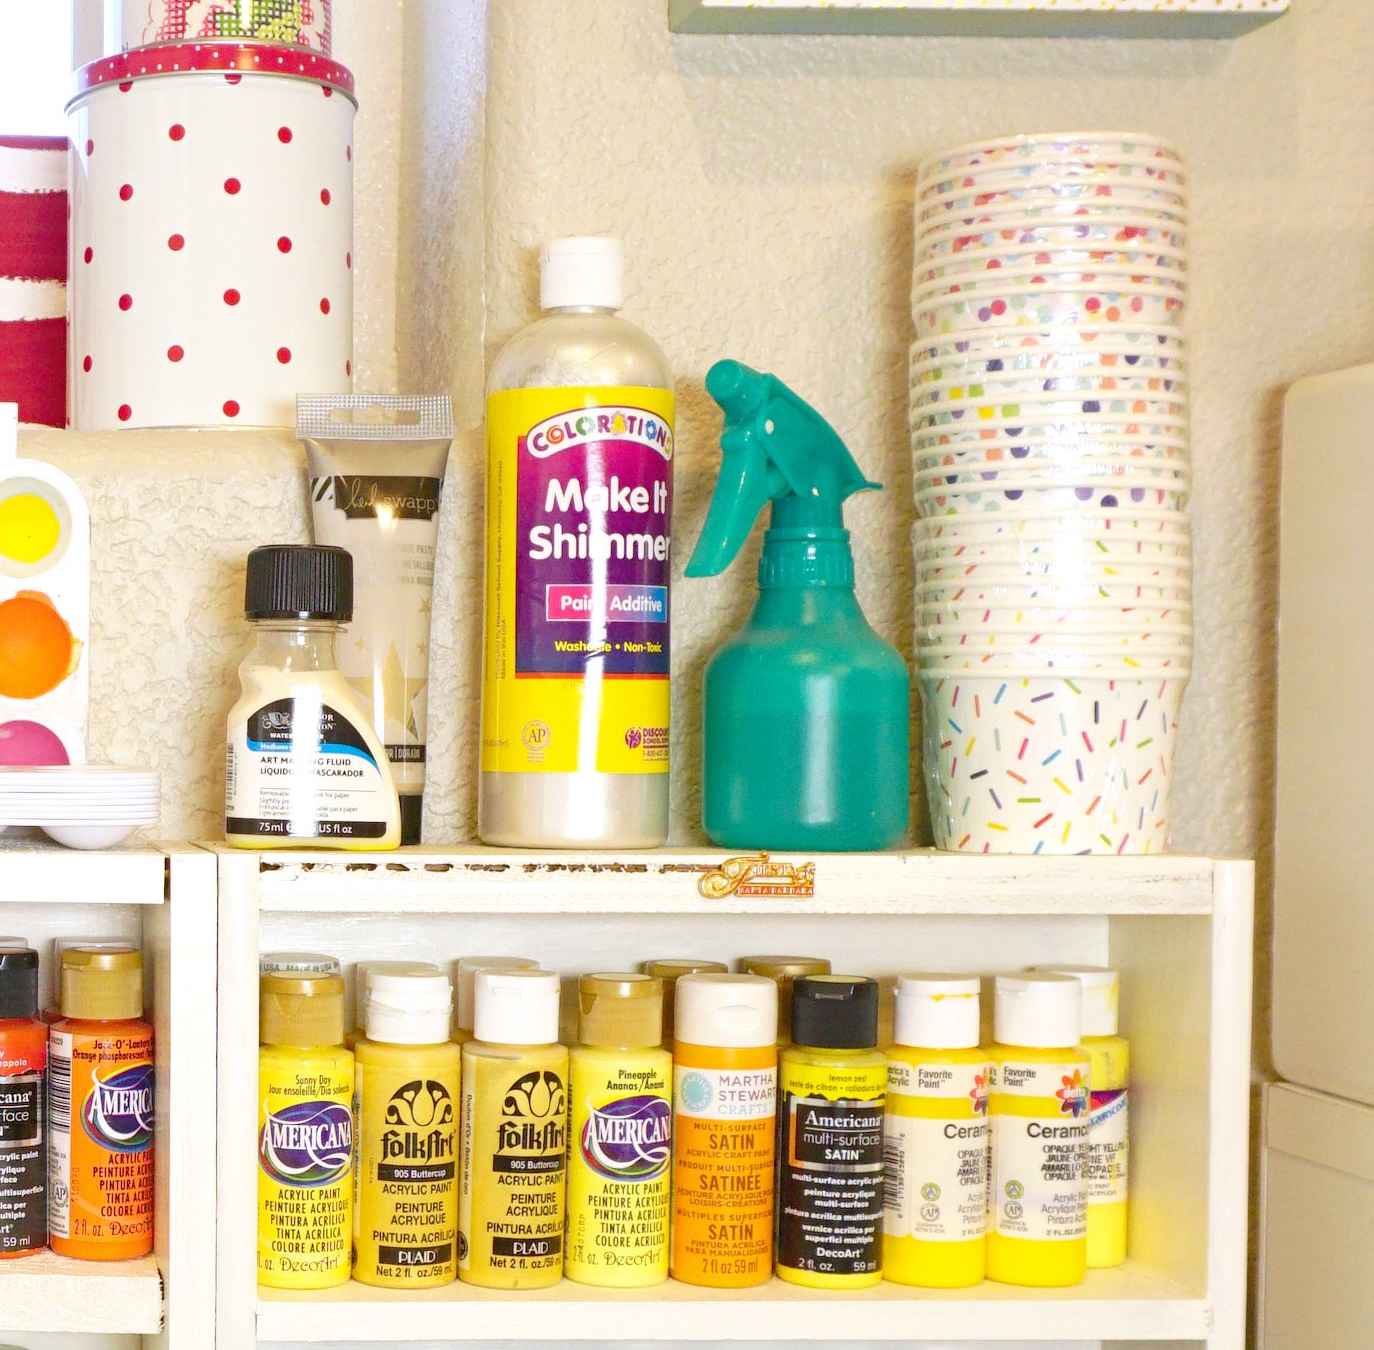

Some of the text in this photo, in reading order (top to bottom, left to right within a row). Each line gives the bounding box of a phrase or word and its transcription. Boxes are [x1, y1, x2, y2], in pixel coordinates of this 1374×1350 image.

[532, 412, 672, 455] COLORATIONS
[545, 477, 667, 515] Make It
[610, 595, 662, 613] Additive
[624, 641, 662, 653] Non-Toxic
[260, 757, 276, 766] ART
[619, 1069, 657, 1082] Pineapple
[719, 1074, 774, 1088] MARTHA
[918, 1069, 953, 1080] Favorite
[296, 1075, 331, 1088] Sunny Day
[718, 1102, 768, 1115] CRAFTS
[261, 1120, 352, 1152] AMERICANA
[709, 1134, 755, 1151] SATIN
[394, 1167, 446, 1178] 905 Buttercup
[699, 1167, 761, 1191] SATINÉE
[398, 1251, 436, 1264] PLAID
